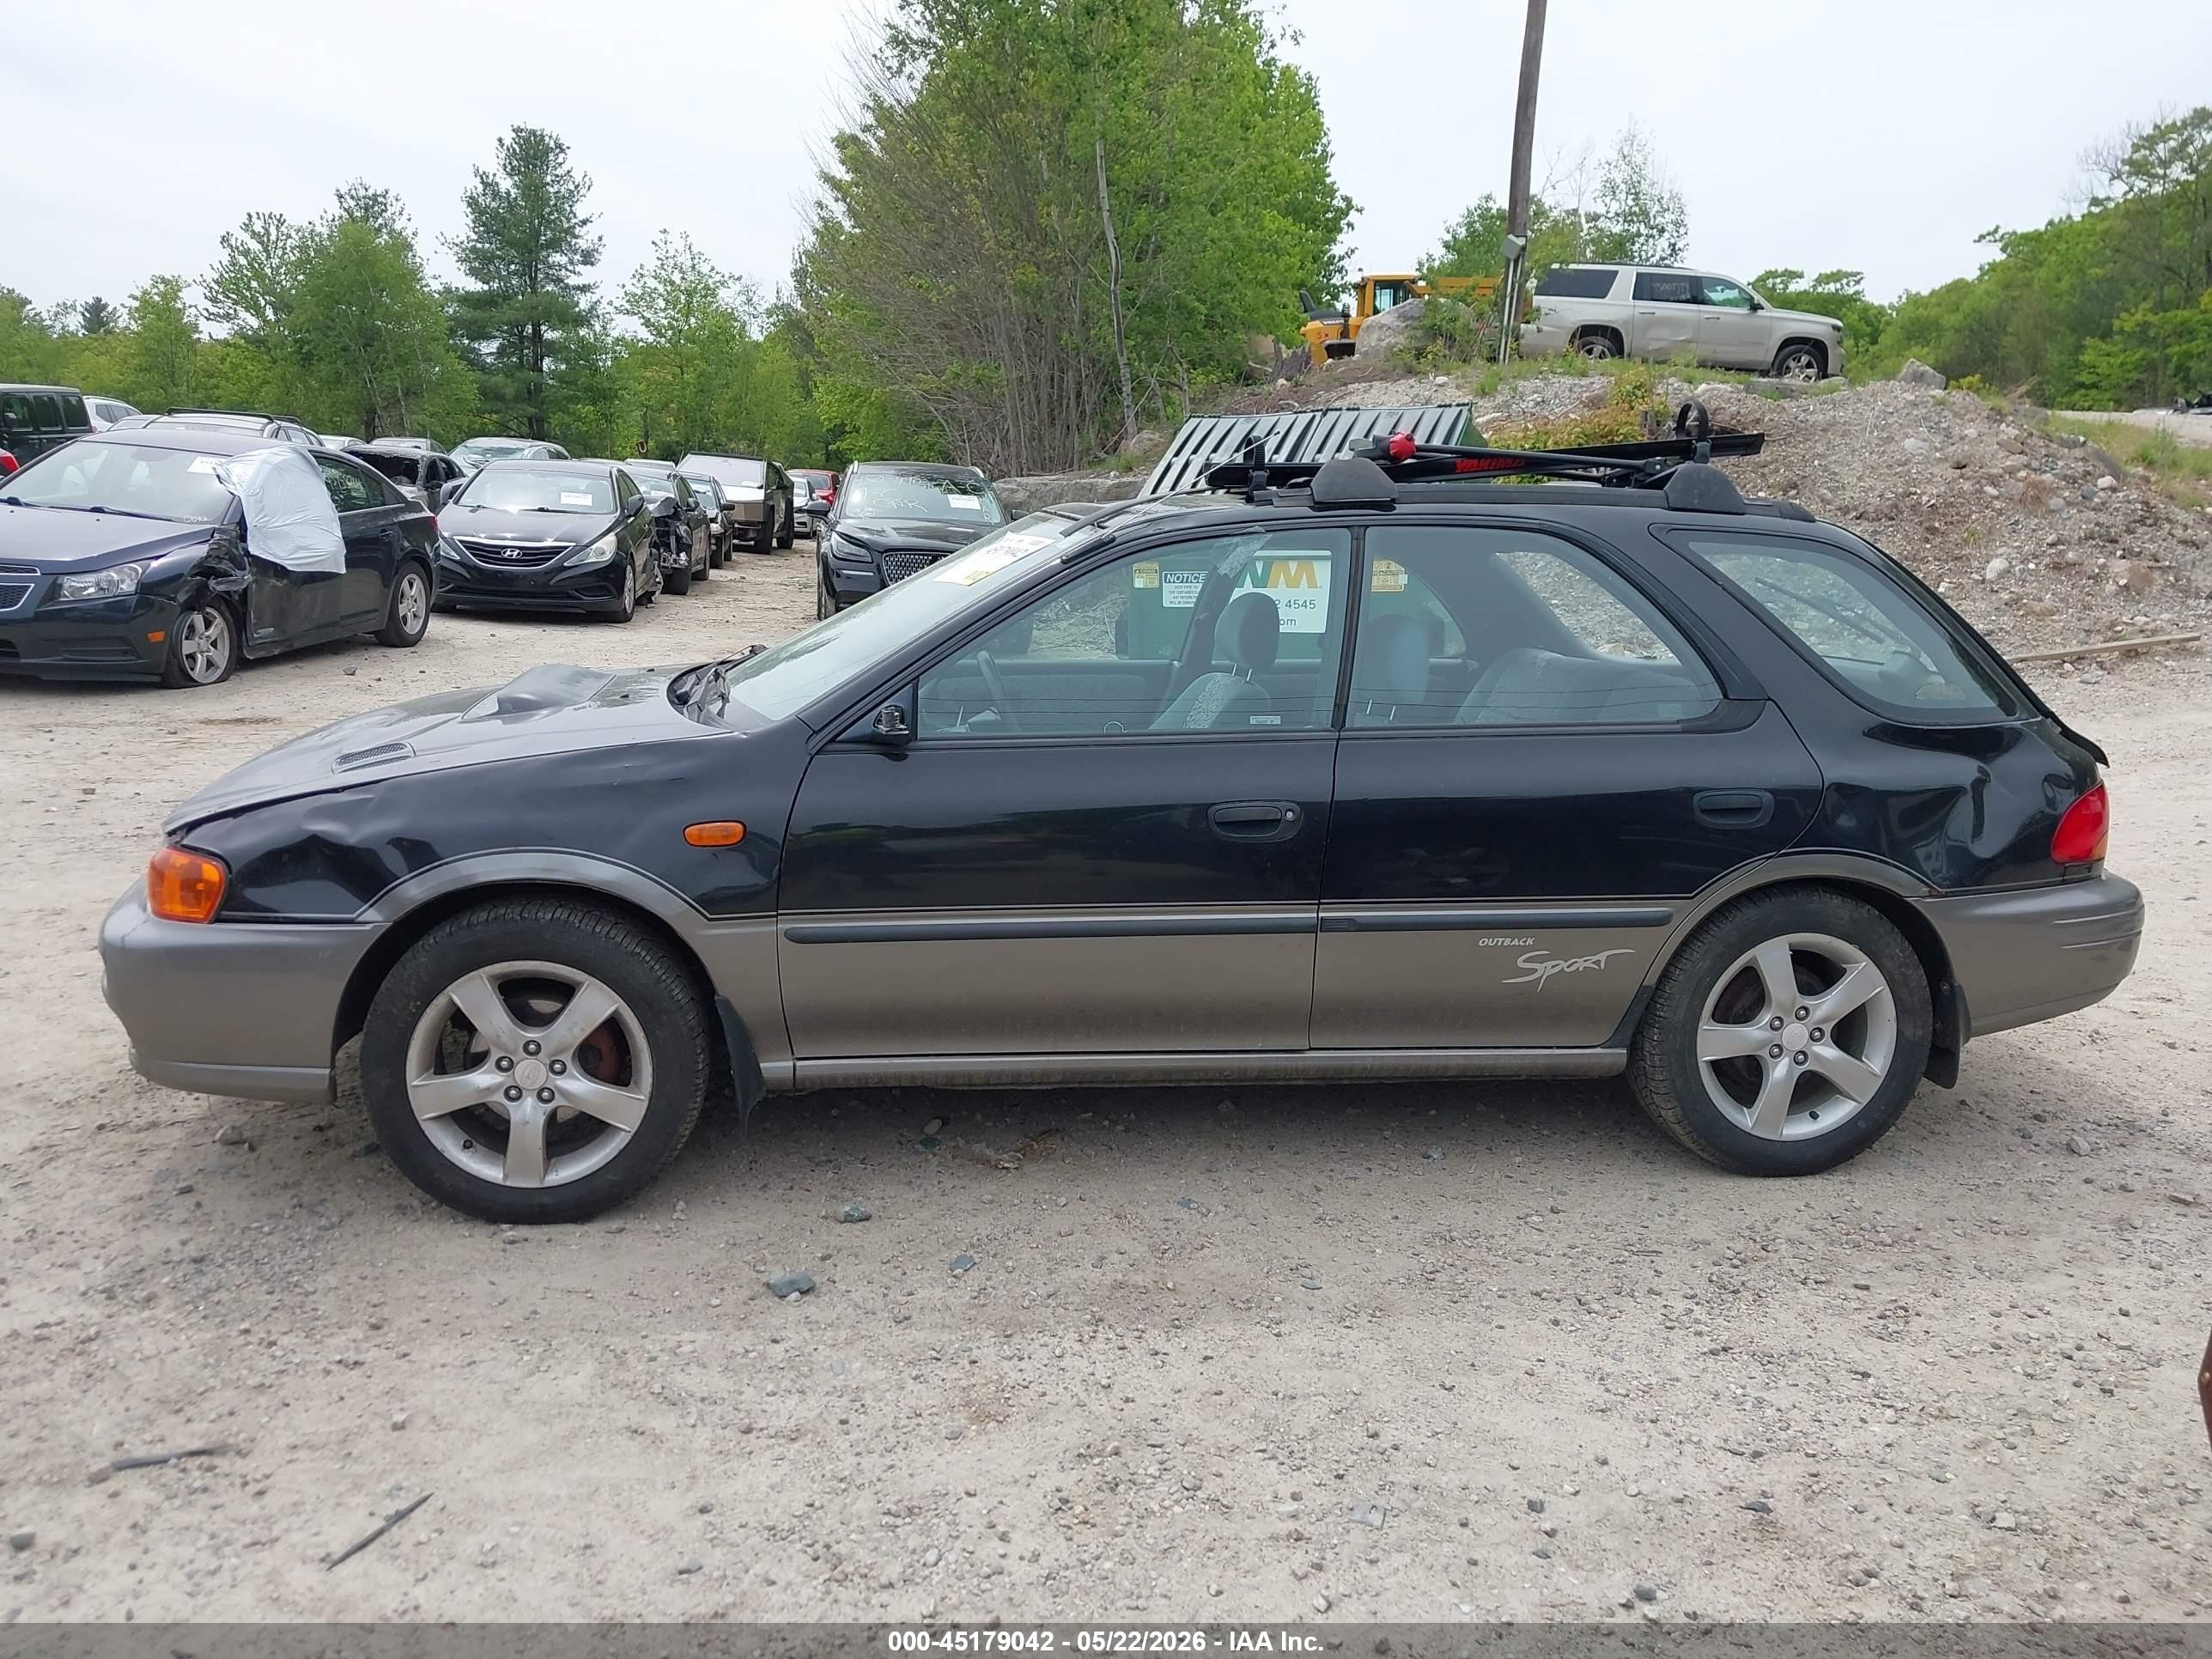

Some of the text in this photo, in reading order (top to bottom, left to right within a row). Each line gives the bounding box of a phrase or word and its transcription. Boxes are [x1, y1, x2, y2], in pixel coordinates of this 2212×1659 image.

[1166, 574, 1206, 583] NOTICE
[1285, 599, 1316, 610] 4545
[1478, 937, 1535, 946] OUTBACK
